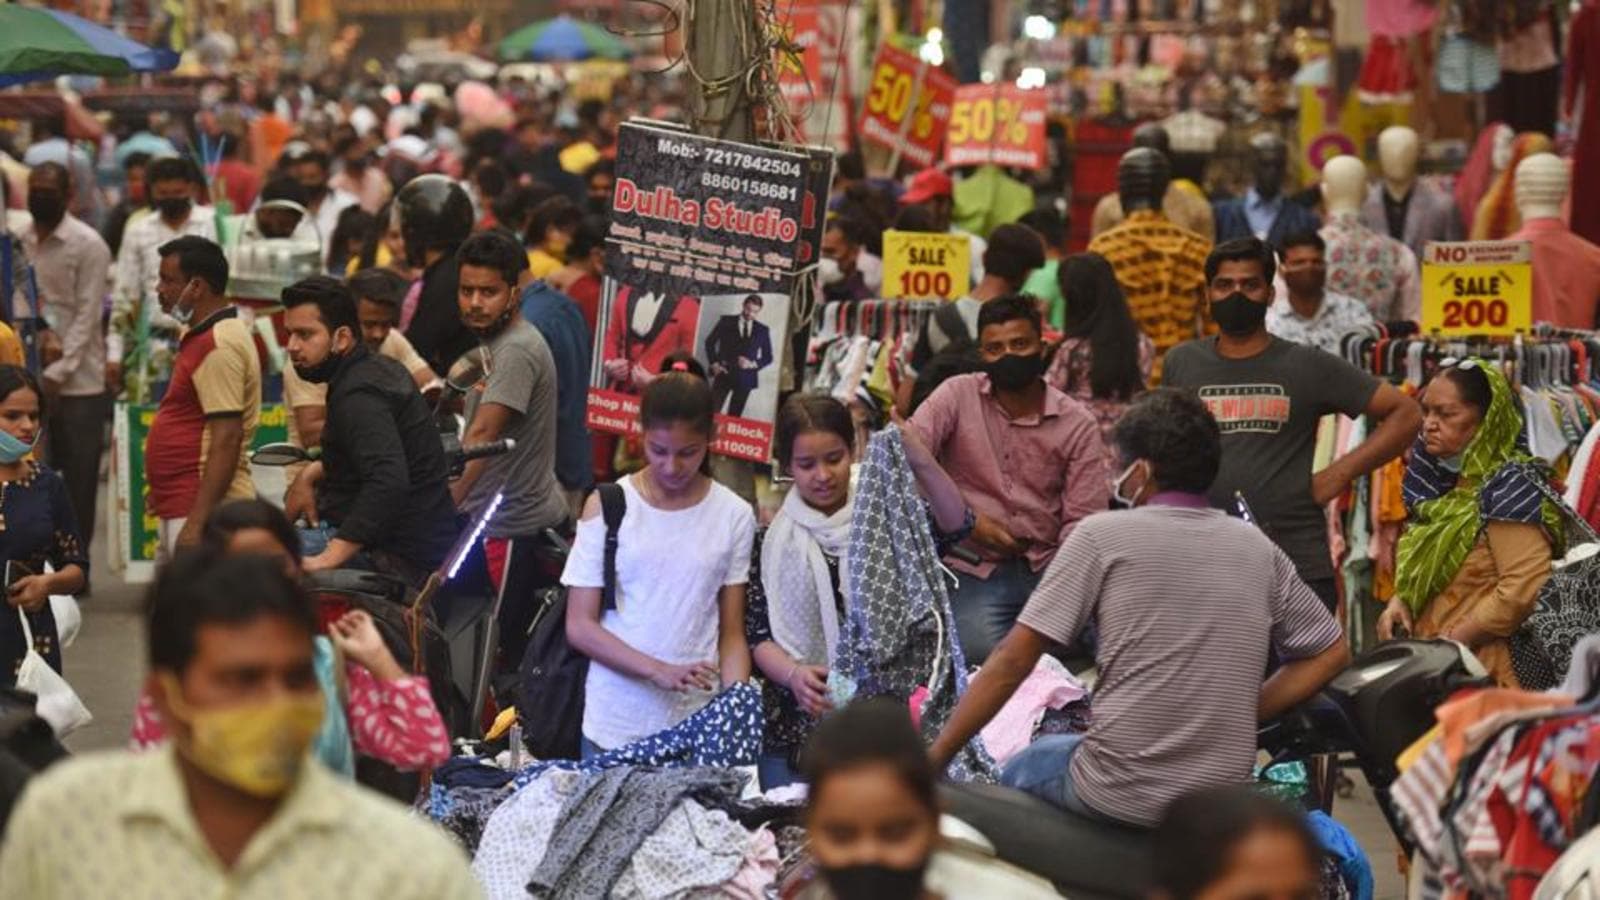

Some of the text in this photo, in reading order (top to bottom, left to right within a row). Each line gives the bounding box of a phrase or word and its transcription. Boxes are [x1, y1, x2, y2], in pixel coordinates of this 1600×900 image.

[948, 98, 1028, 146] 50%
[657, 139, 801, 177] Mob:- 7217842504
[701, 172, 798, 201] 8860158681
[613, 178, 699, 226] Dulha
[703, 196, 797, 242] Studio
[908, 246, 946, 266] SALE
[1434, 247, 1467, 263] NO
[900, 271, 952, 297] 100
[1453, 276, 1501, 297] SALE
[1442, 298, 1508, 328] 200
[587, 393, 619, 412] Shop
[589, 411, 628, 430] Laxmi
